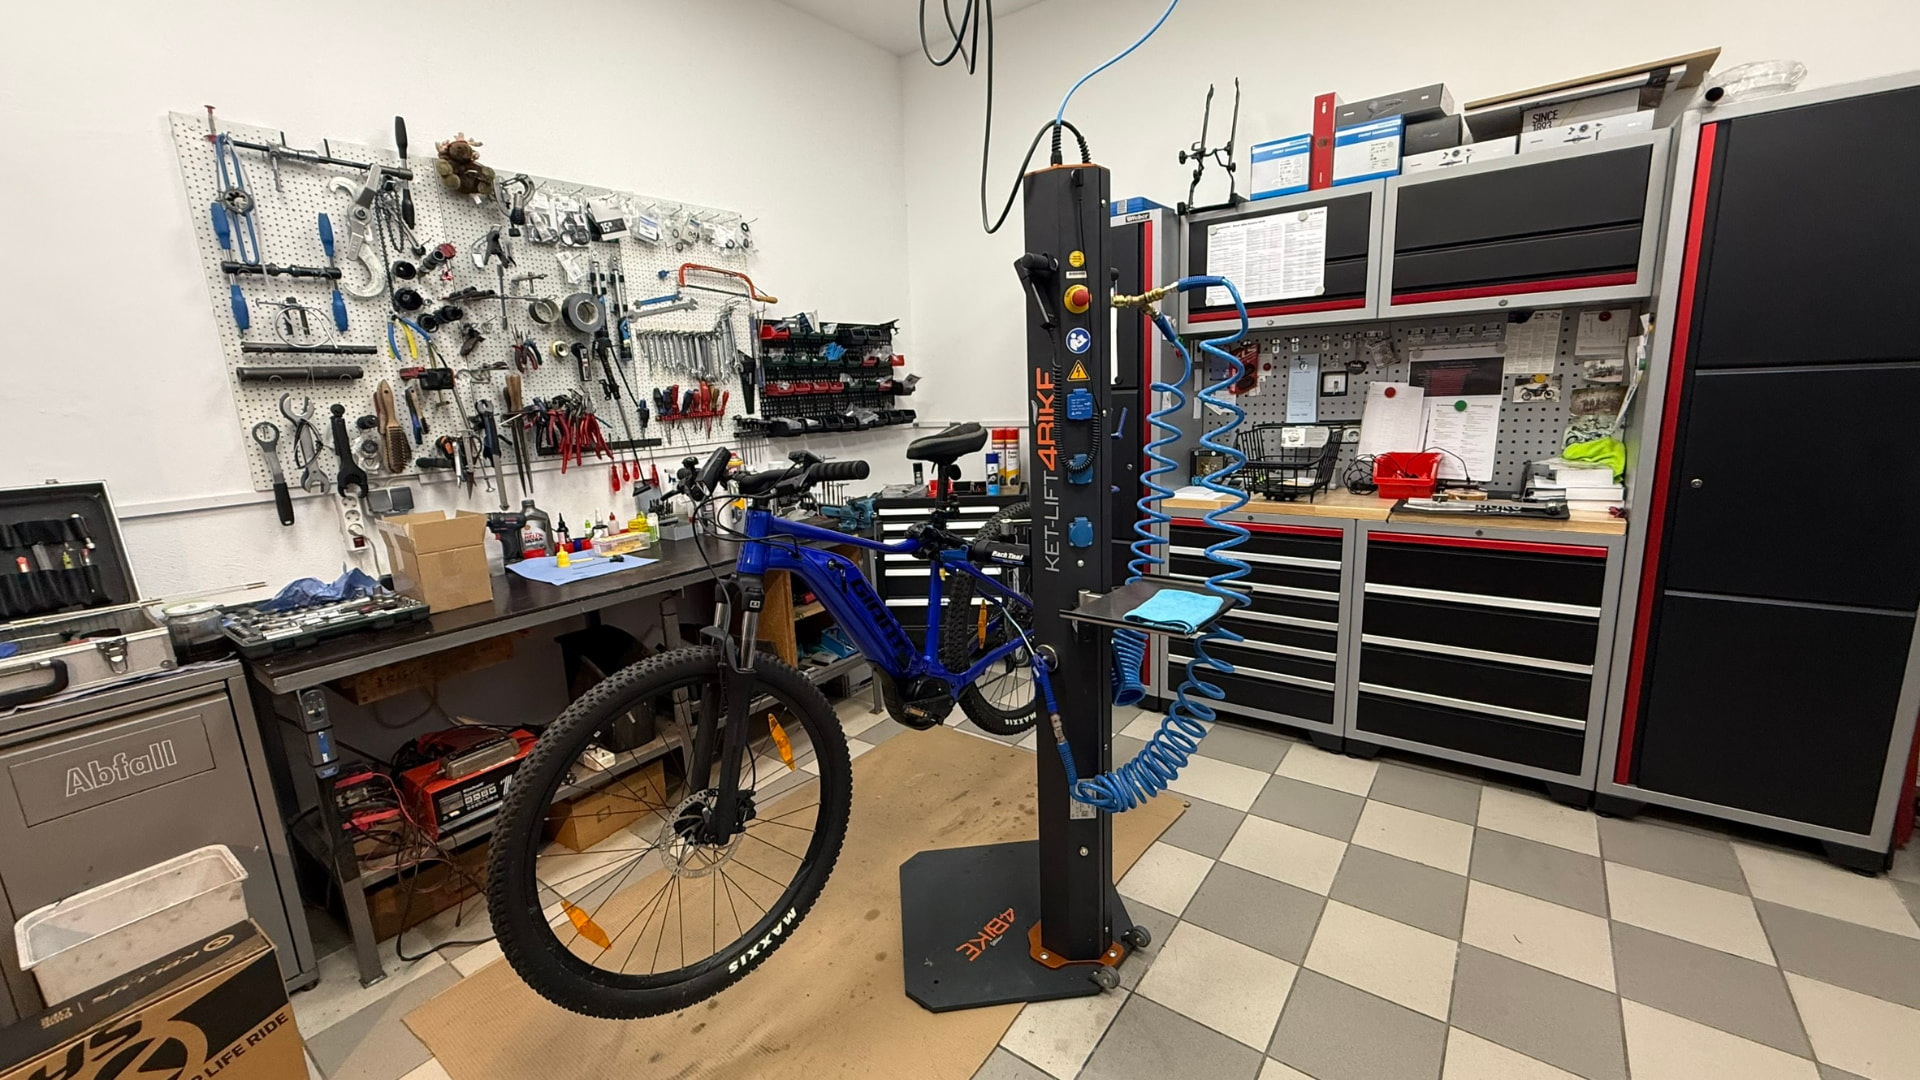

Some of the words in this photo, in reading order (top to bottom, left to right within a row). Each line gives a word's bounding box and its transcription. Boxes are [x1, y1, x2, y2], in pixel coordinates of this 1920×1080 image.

[1532, 109, 1559, 122] SINCE
[1043, 469, 1060, 572] KET-LIFT
[1004, 711, 1037, 726] MAXXIS
[65, 739, 177, 797] Abfall
[728, 906, 797, 974] MAXXIS
[955, 907, 1015, 961] 4BIKE
[204, 1043, 246, 1078] LIFE
[245, 1012, 289, 1047] RIDE
